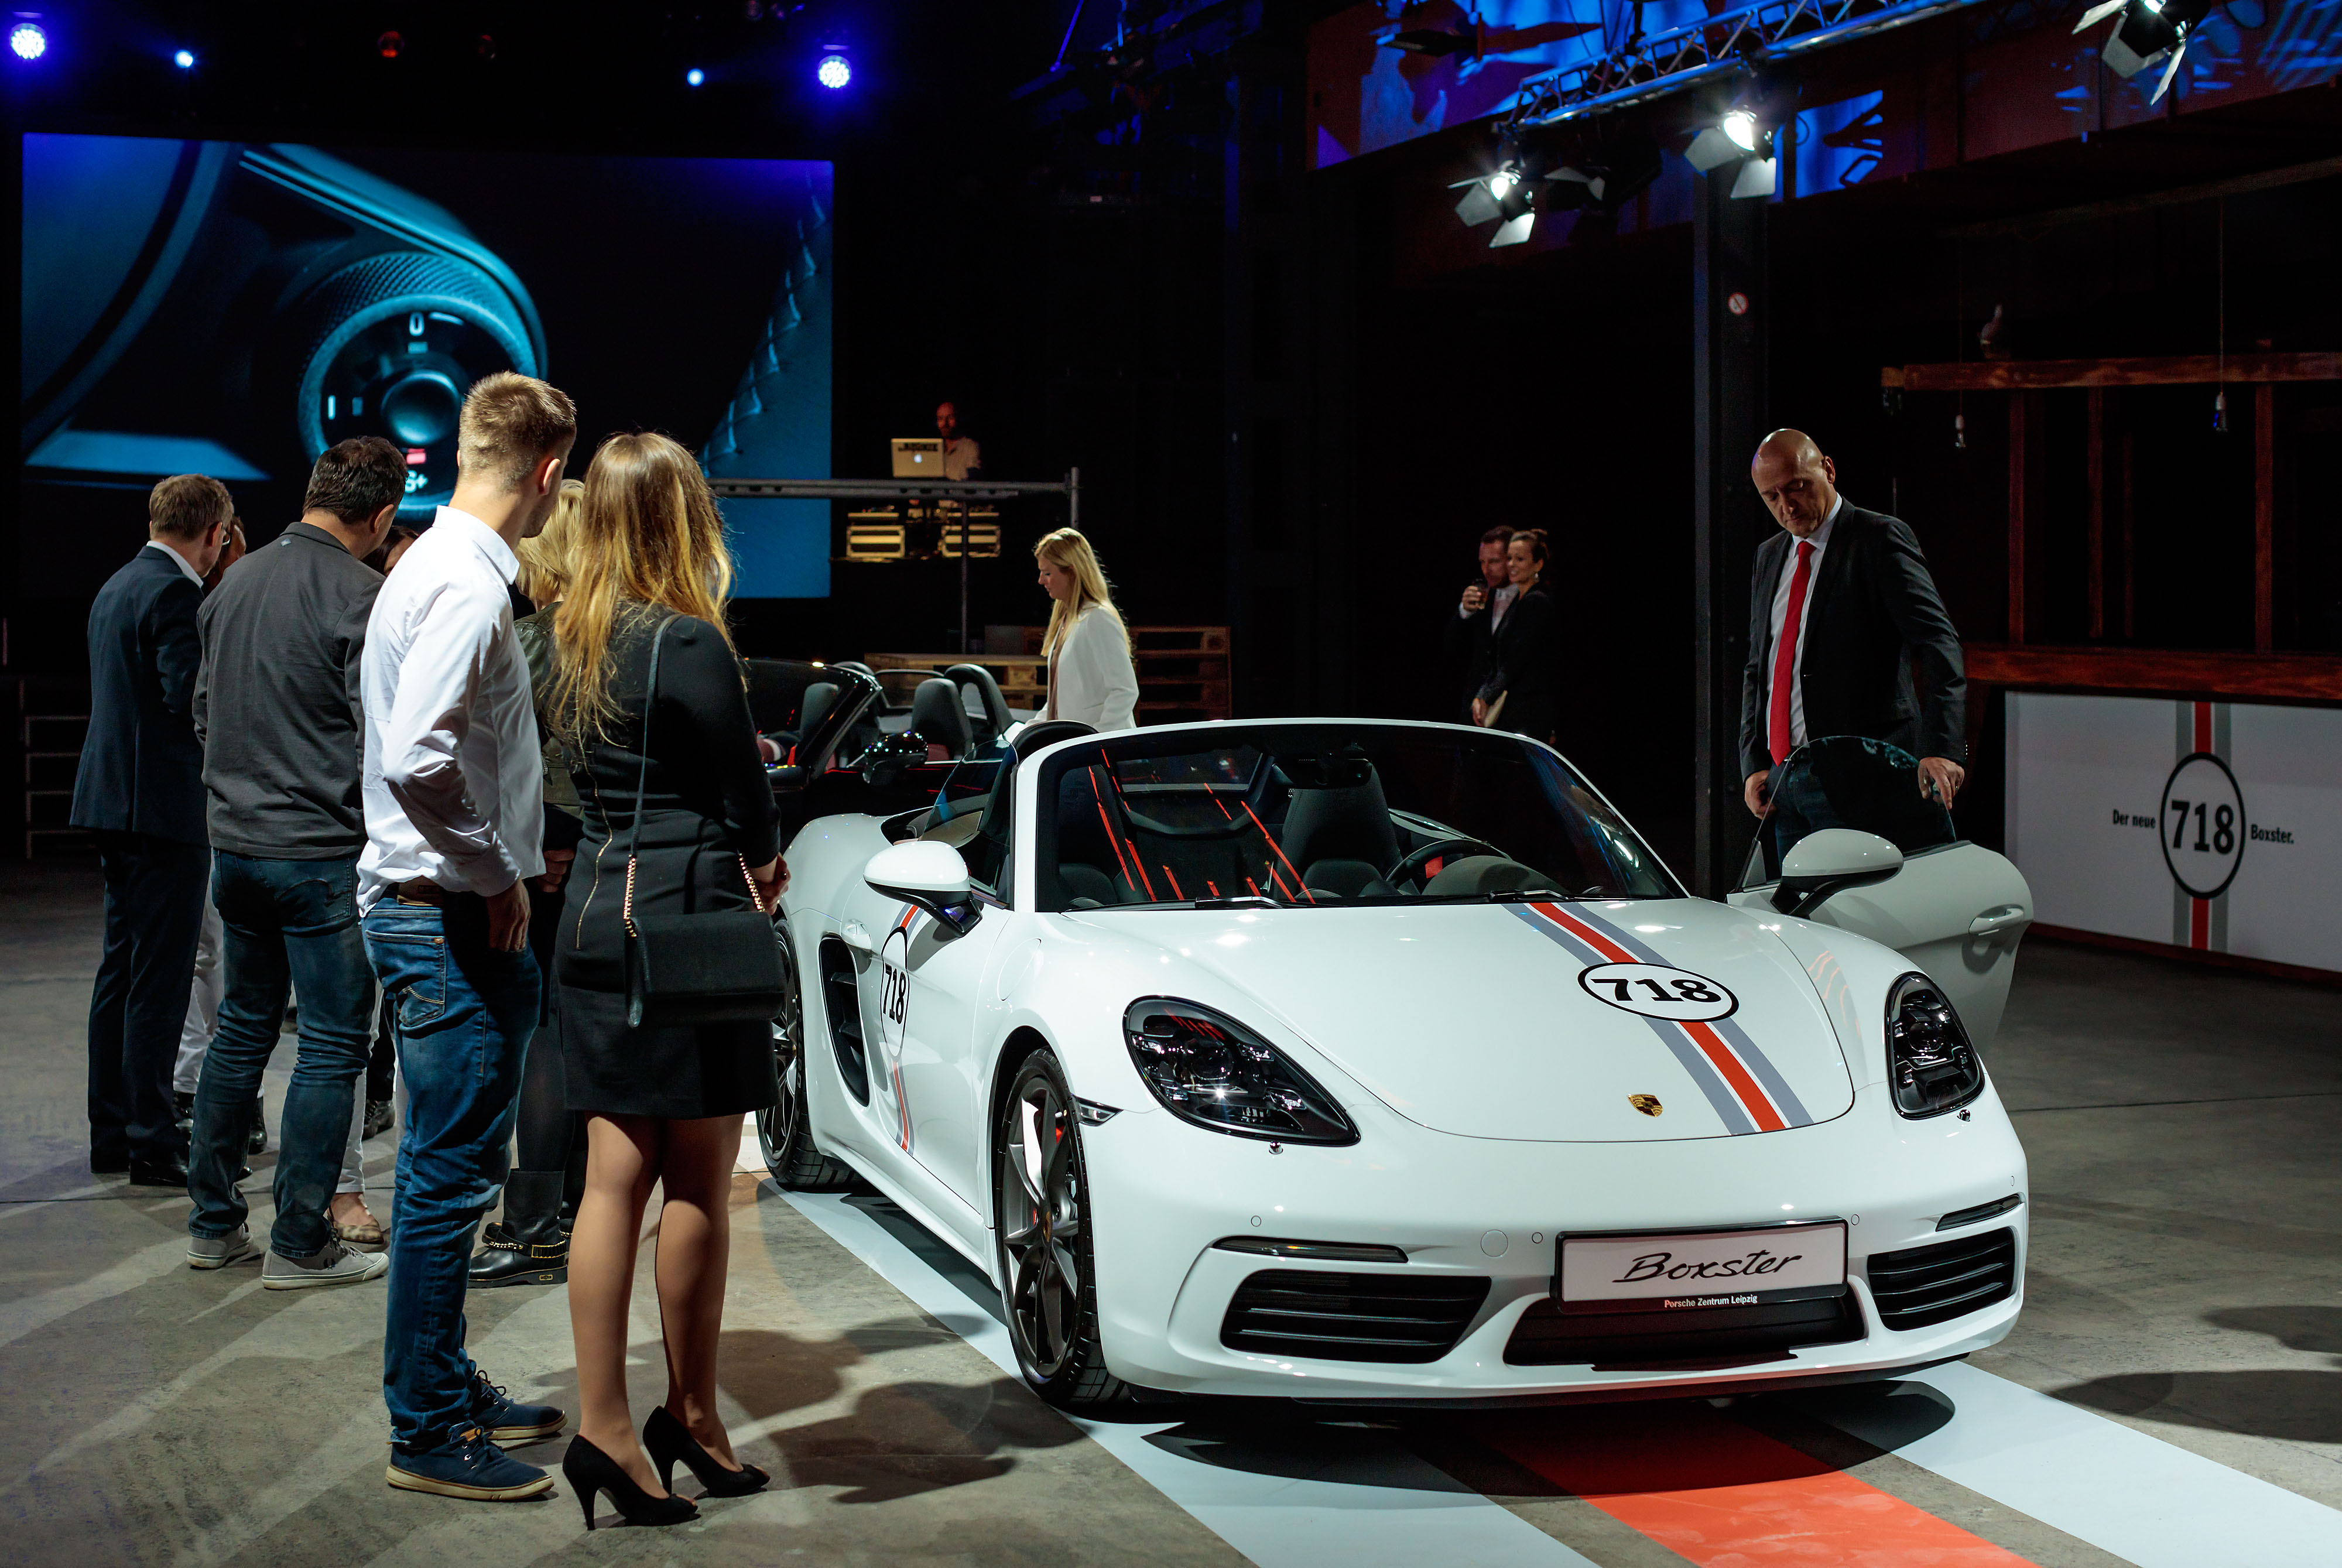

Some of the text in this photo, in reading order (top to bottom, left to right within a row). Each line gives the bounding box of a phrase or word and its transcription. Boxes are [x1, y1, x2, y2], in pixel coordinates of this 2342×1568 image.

[2112, 800, 2294, 855] Der neue 718 Boxster.
[883, 963, 907, 1024] 718
[1590, 978, 1721, 1003] 718
[1611, 1249, 1802, 1283] Boxster
[1664, 1294, 1758, 1308] Porsche Zentrum Leipzig
